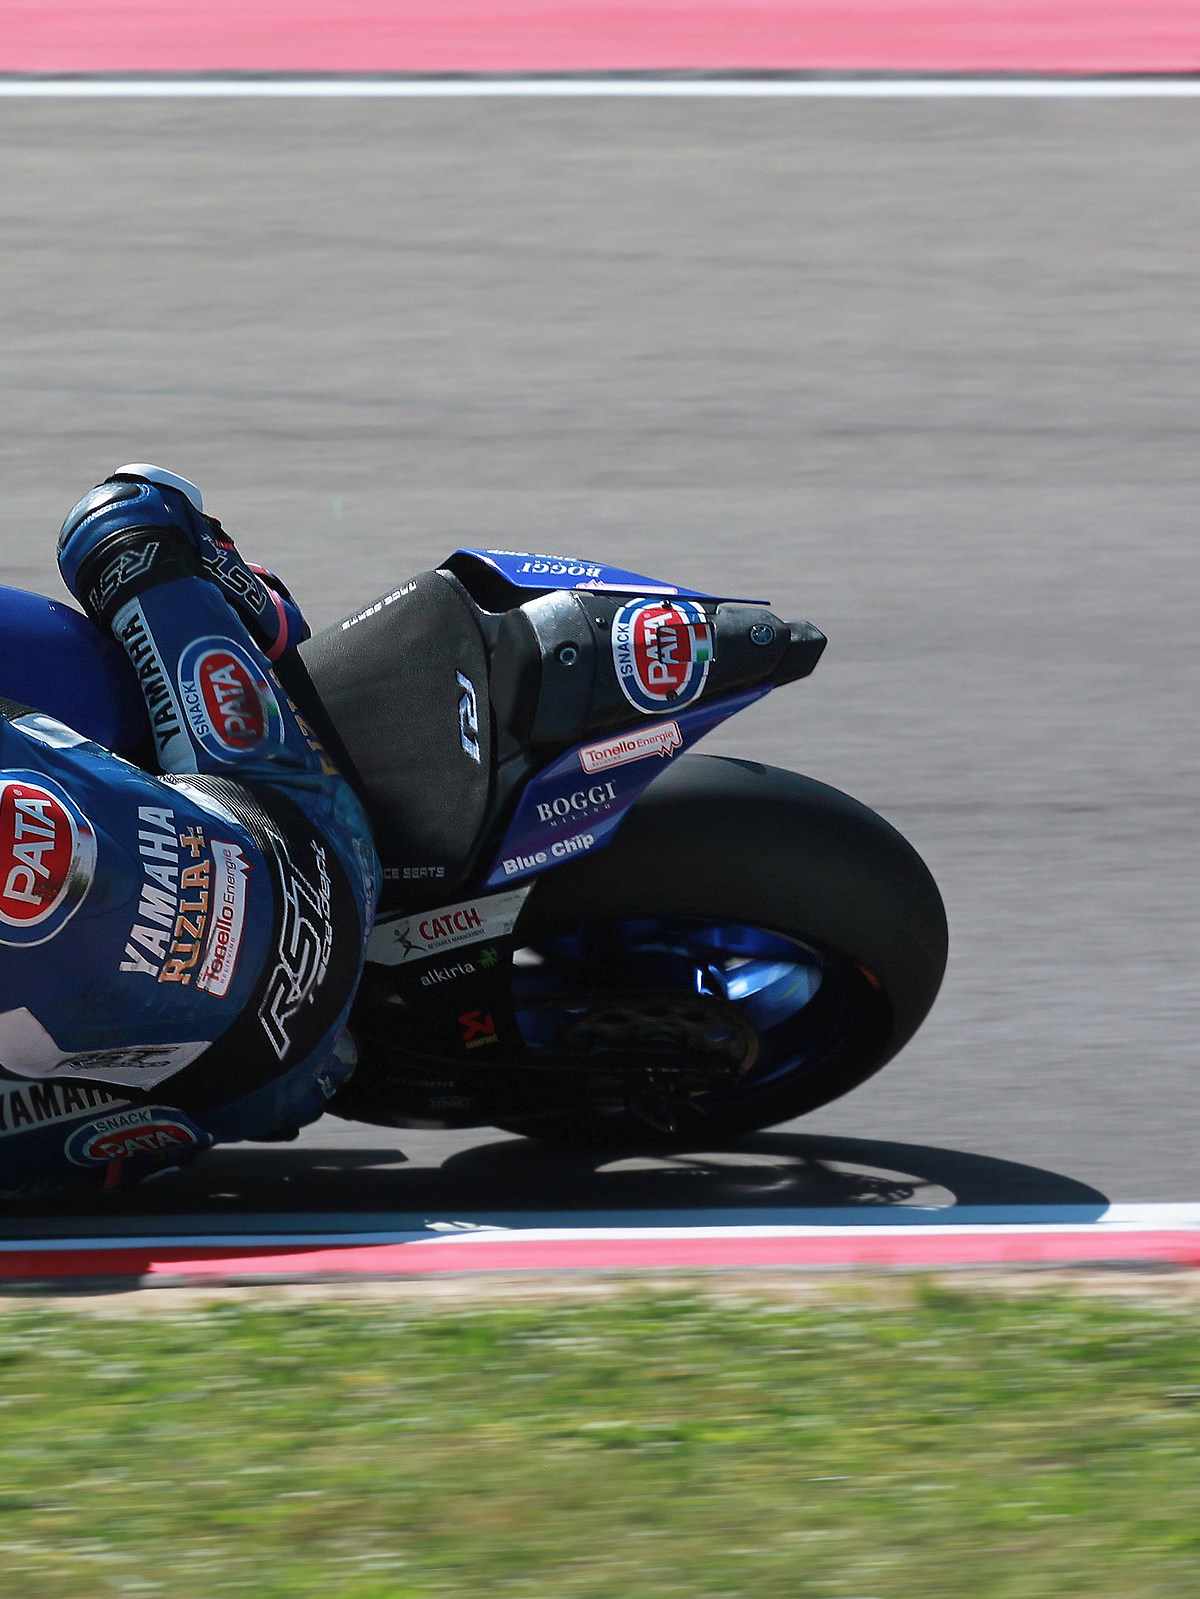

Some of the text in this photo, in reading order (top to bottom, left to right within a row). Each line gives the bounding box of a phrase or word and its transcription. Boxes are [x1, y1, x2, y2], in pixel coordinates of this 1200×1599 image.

[522, 562, 602, 578] BOGGI
[617, 621, 633, 676] SNACK
[643, 611, 679, 686] PATA
[125, 612, 181, 752] YAMAHA
[185, 681, 211, 737] SNACK
[210, 663, 255, 746] PATA
[587, 729, 675, 763] Tonello Energie
[536, 781, 617, 822] BOGGI
[550, 804, 612, 827] MILANO
[2, 797, 58, 906] PATA
[502, 833, 597, 876] Blue Chip
[118, 806, 177, 977] YAMAHA
[402, 866, 445, 880] SEATS
[202, 847, 237, 984] Tonello Energie
[419, 907, 482, 941] CATCH
[420, 960, 476, 986] alkiria
[96, 1110, 150, 1133] SNACK
[98, 1130, 184, 1158] PATA
